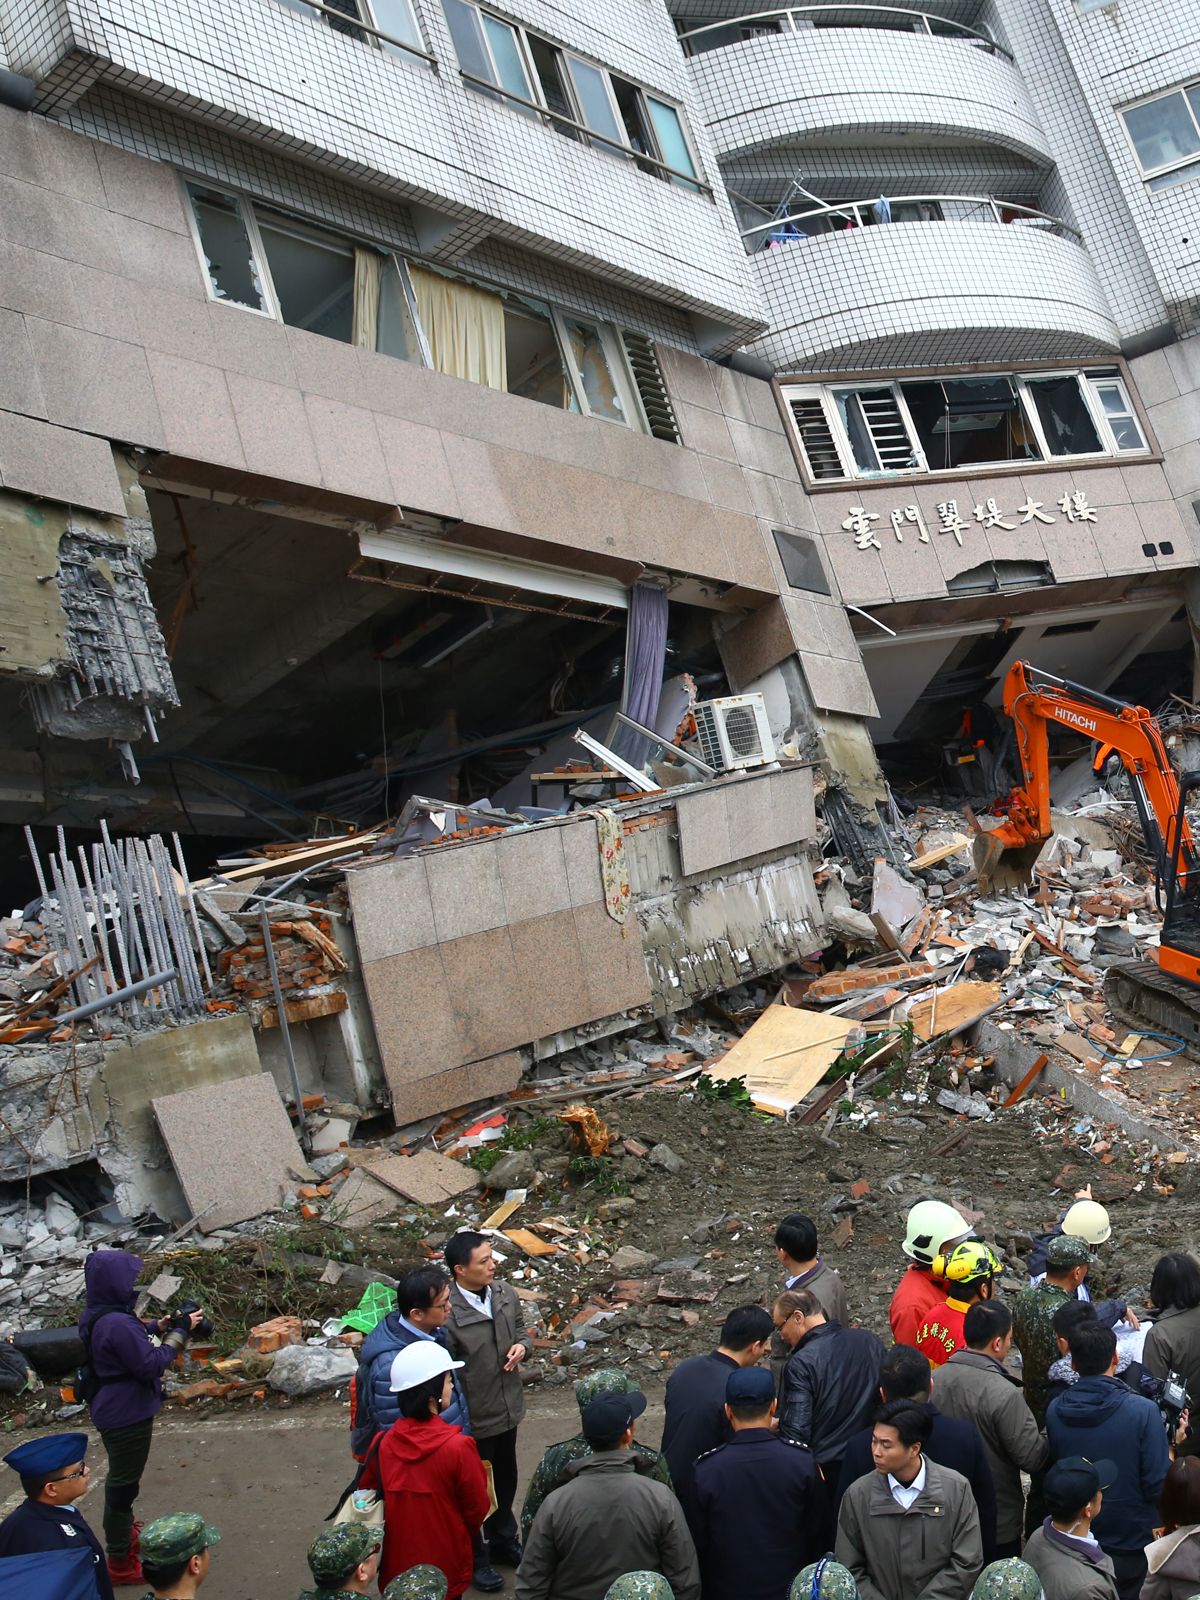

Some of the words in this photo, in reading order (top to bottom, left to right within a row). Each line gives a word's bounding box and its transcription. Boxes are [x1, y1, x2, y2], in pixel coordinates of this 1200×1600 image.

[842, 490, 1099, 550] 雲門翠堤大樓
[1055, 706, 1096, 732] HITACHI
